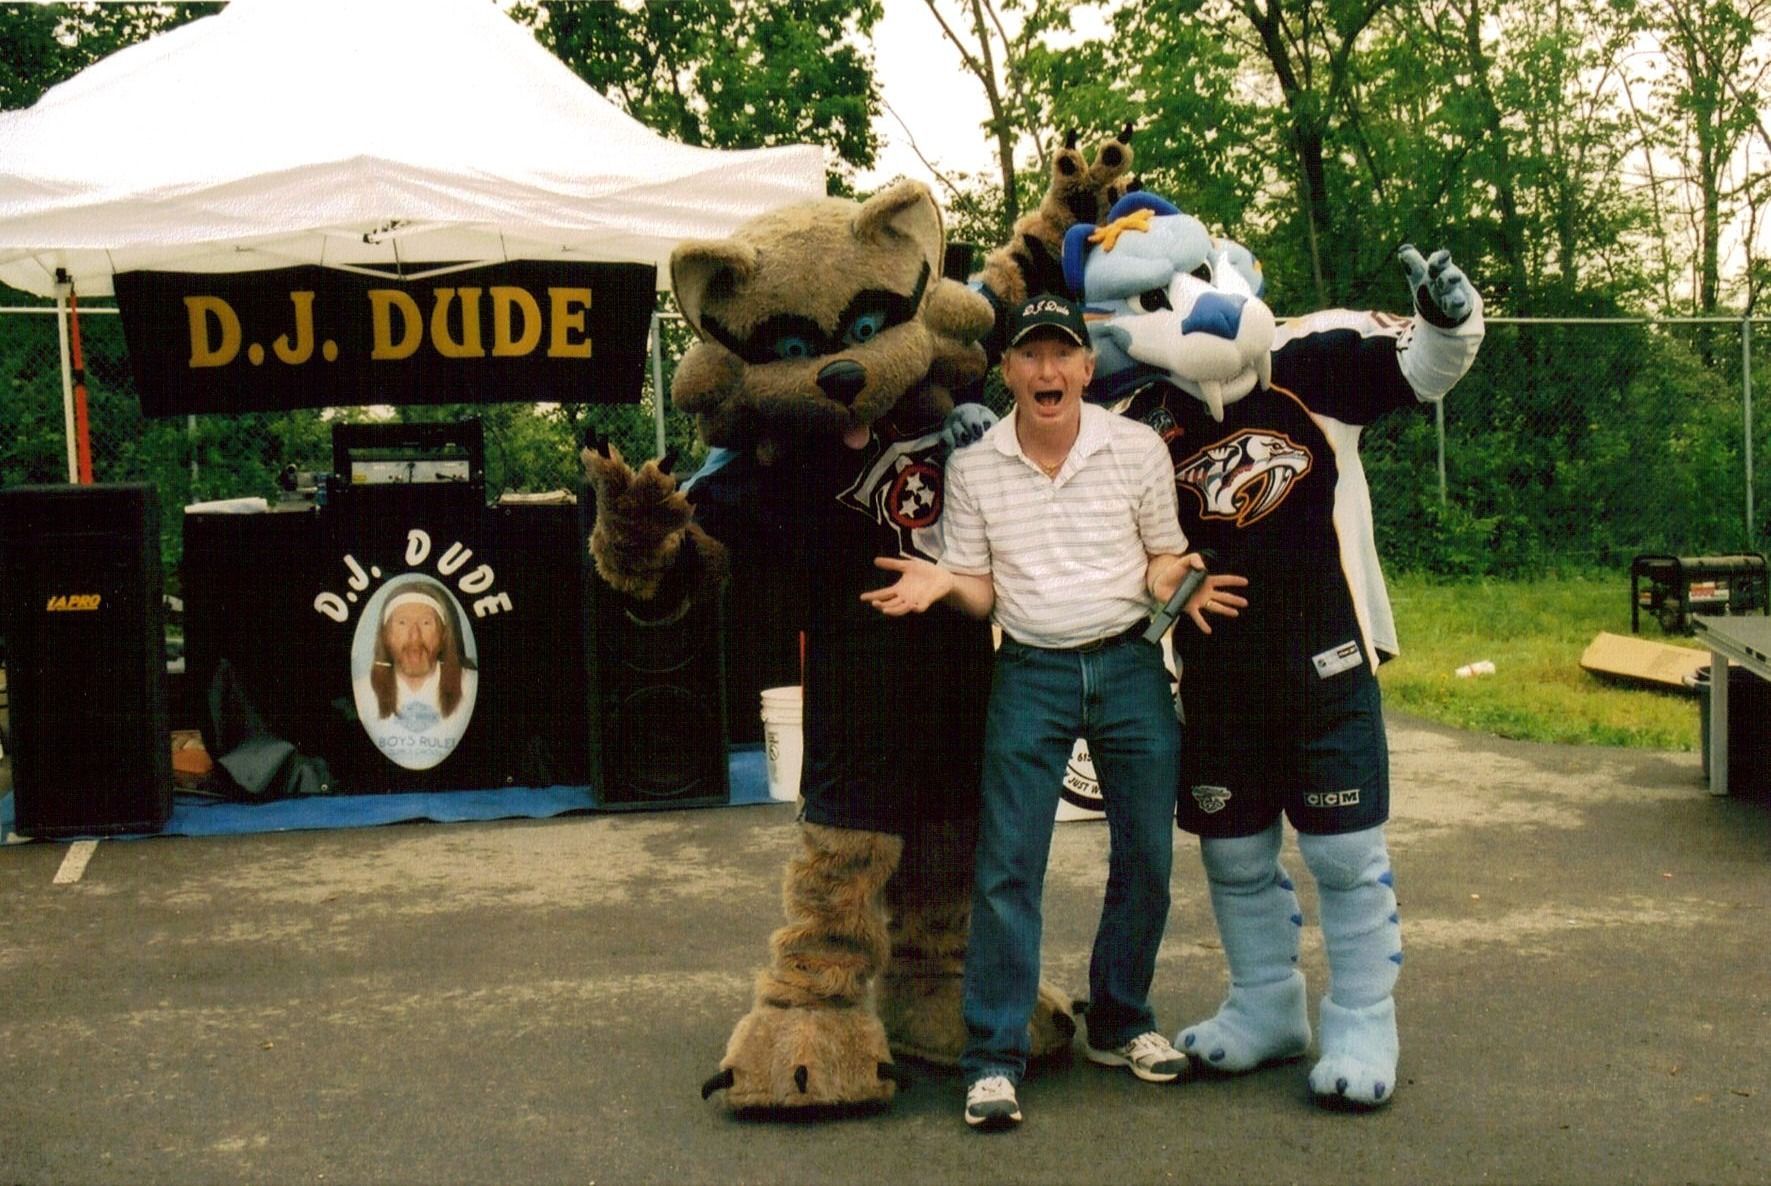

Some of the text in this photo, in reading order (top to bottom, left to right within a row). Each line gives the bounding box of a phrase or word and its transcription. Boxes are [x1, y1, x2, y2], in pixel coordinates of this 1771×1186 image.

[184, 286, 592, 368] D.J. DUDE
[313, 528, 513, 623] D.J. DUDE
[379, 736, 415, 748] BOYS
[1067, 778, 1089, 791] JUST
[1306, 789, 1358, 805] CCM
